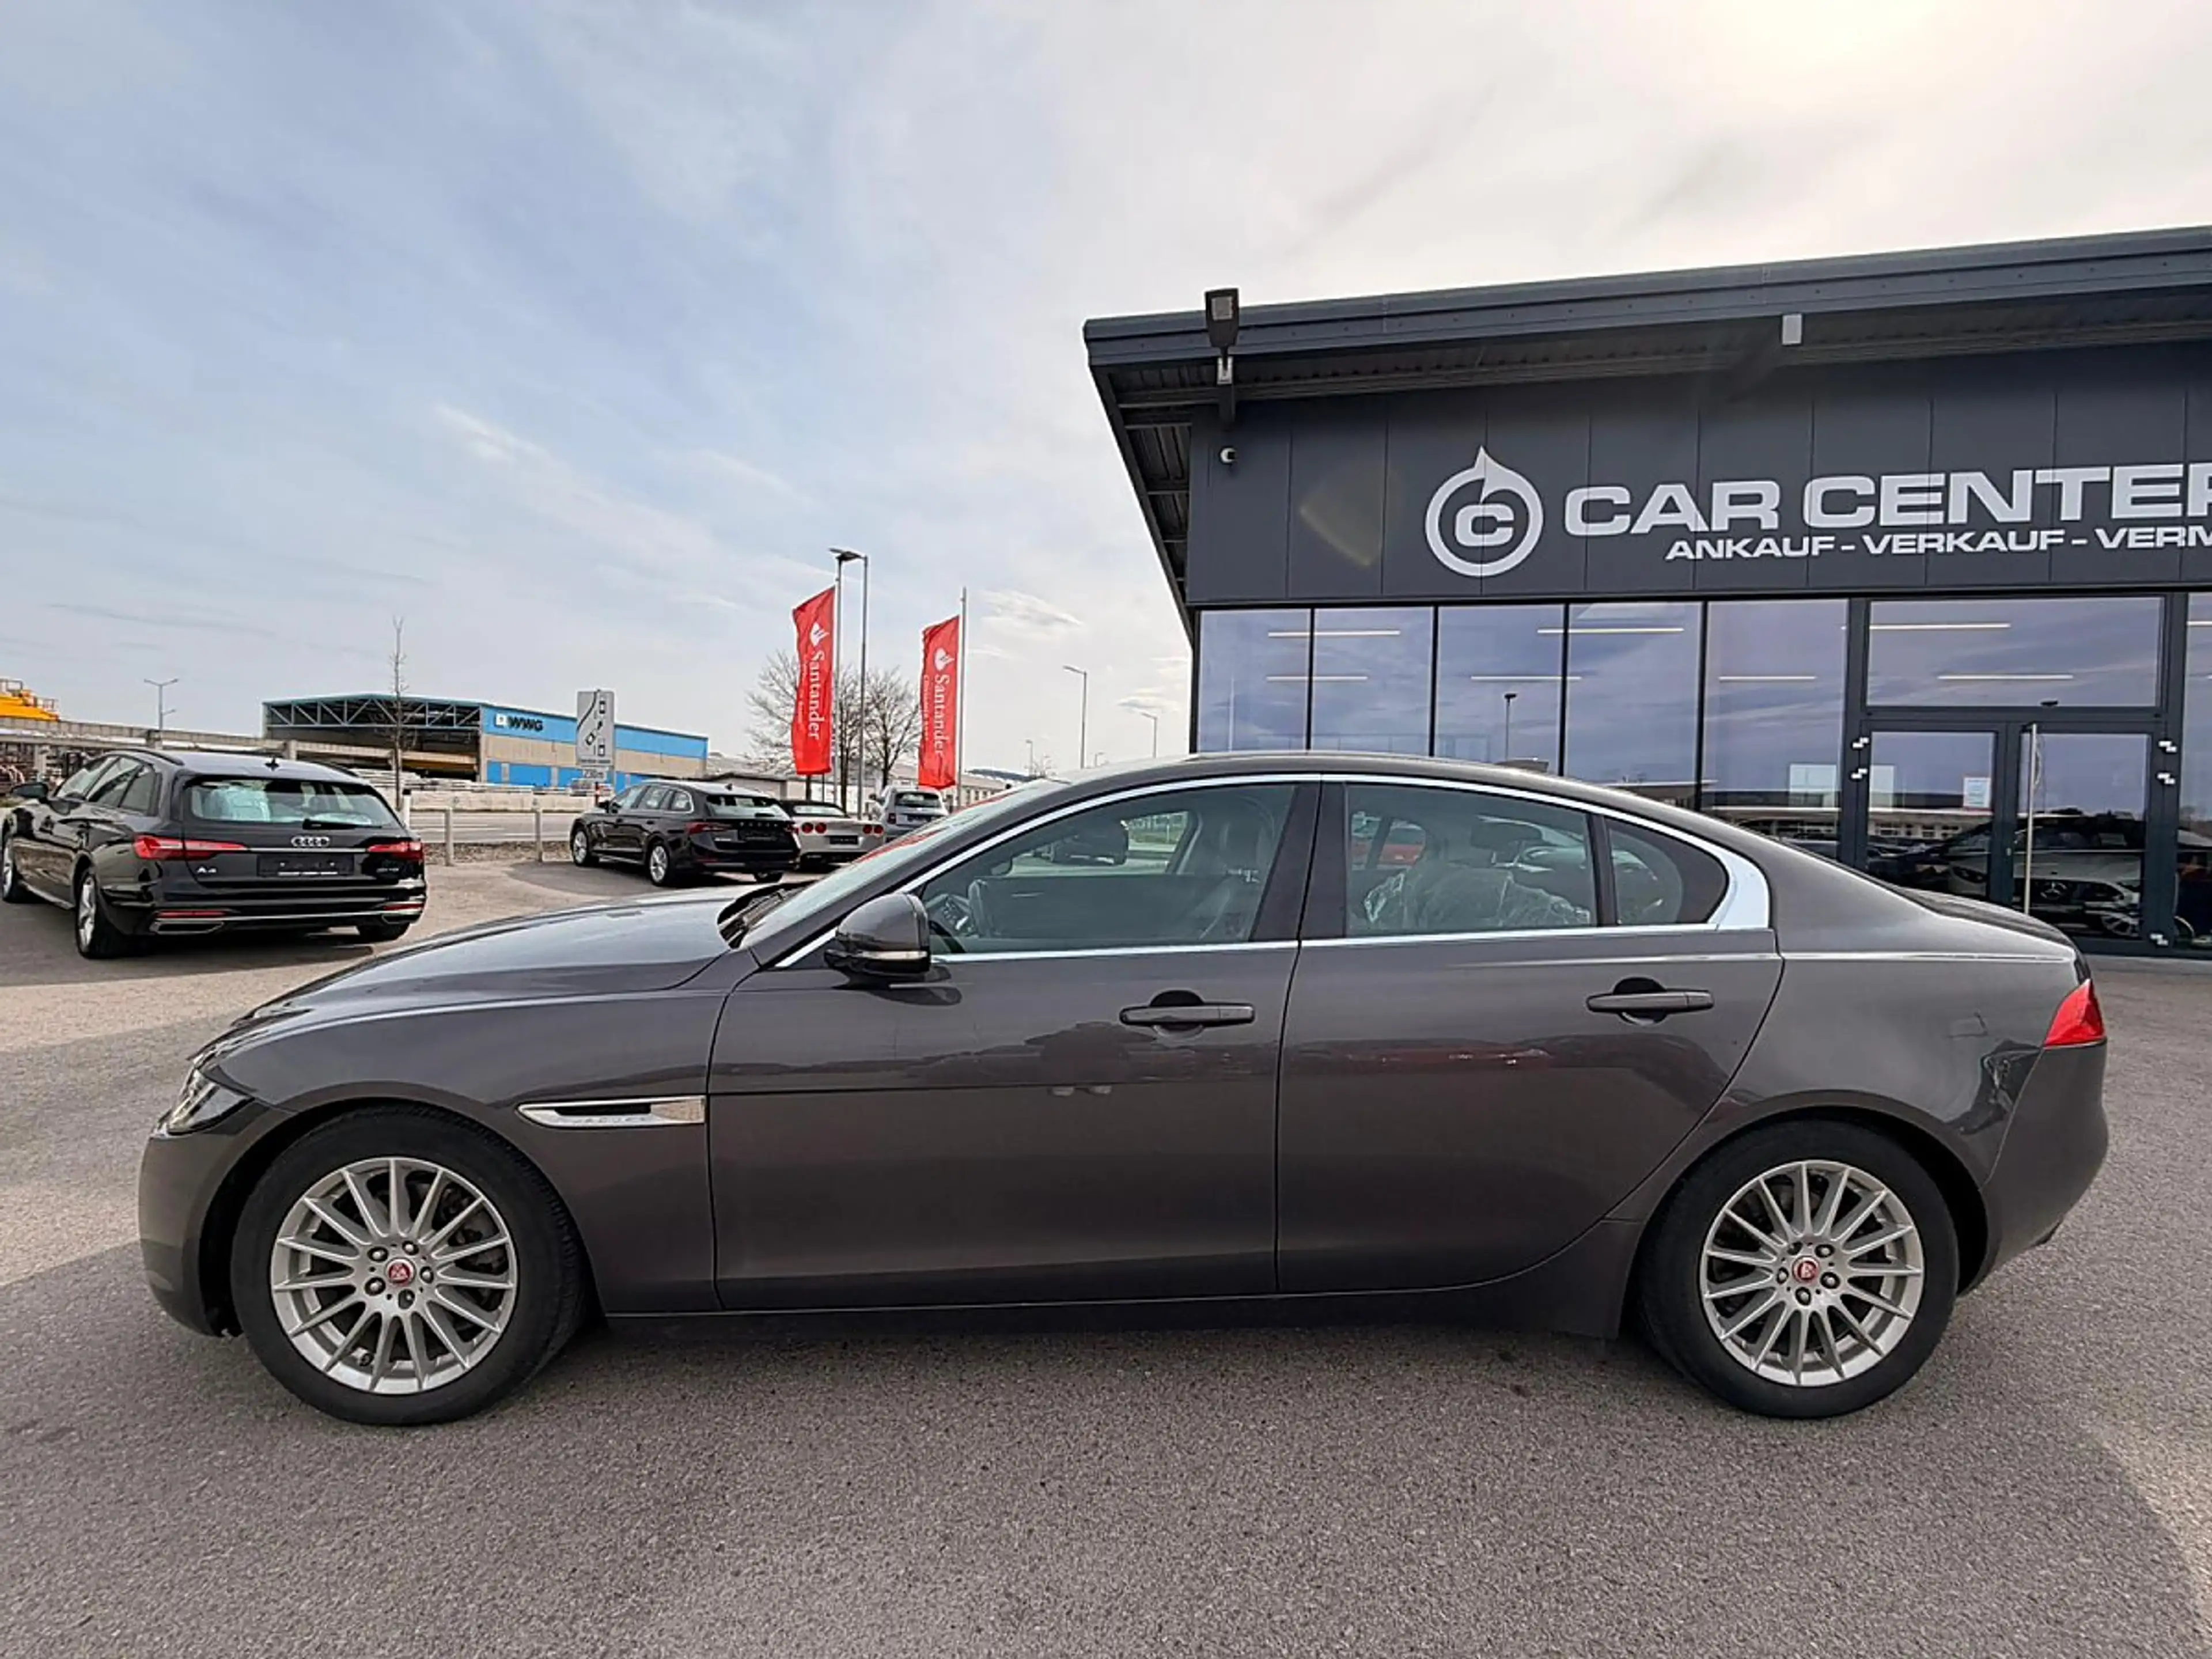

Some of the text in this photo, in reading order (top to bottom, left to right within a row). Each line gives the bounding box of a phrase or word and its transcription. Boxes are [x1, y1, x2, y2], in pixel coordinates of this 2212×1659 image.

[1564, 479, 1781, 536] CAR
[1665, 535, 1836, 560] ANKAUF
[1861, 529, 2065, 555] VERKAUF
[808, 650, 825, 740] Santander
[933, 673, 950, 756] Santander
